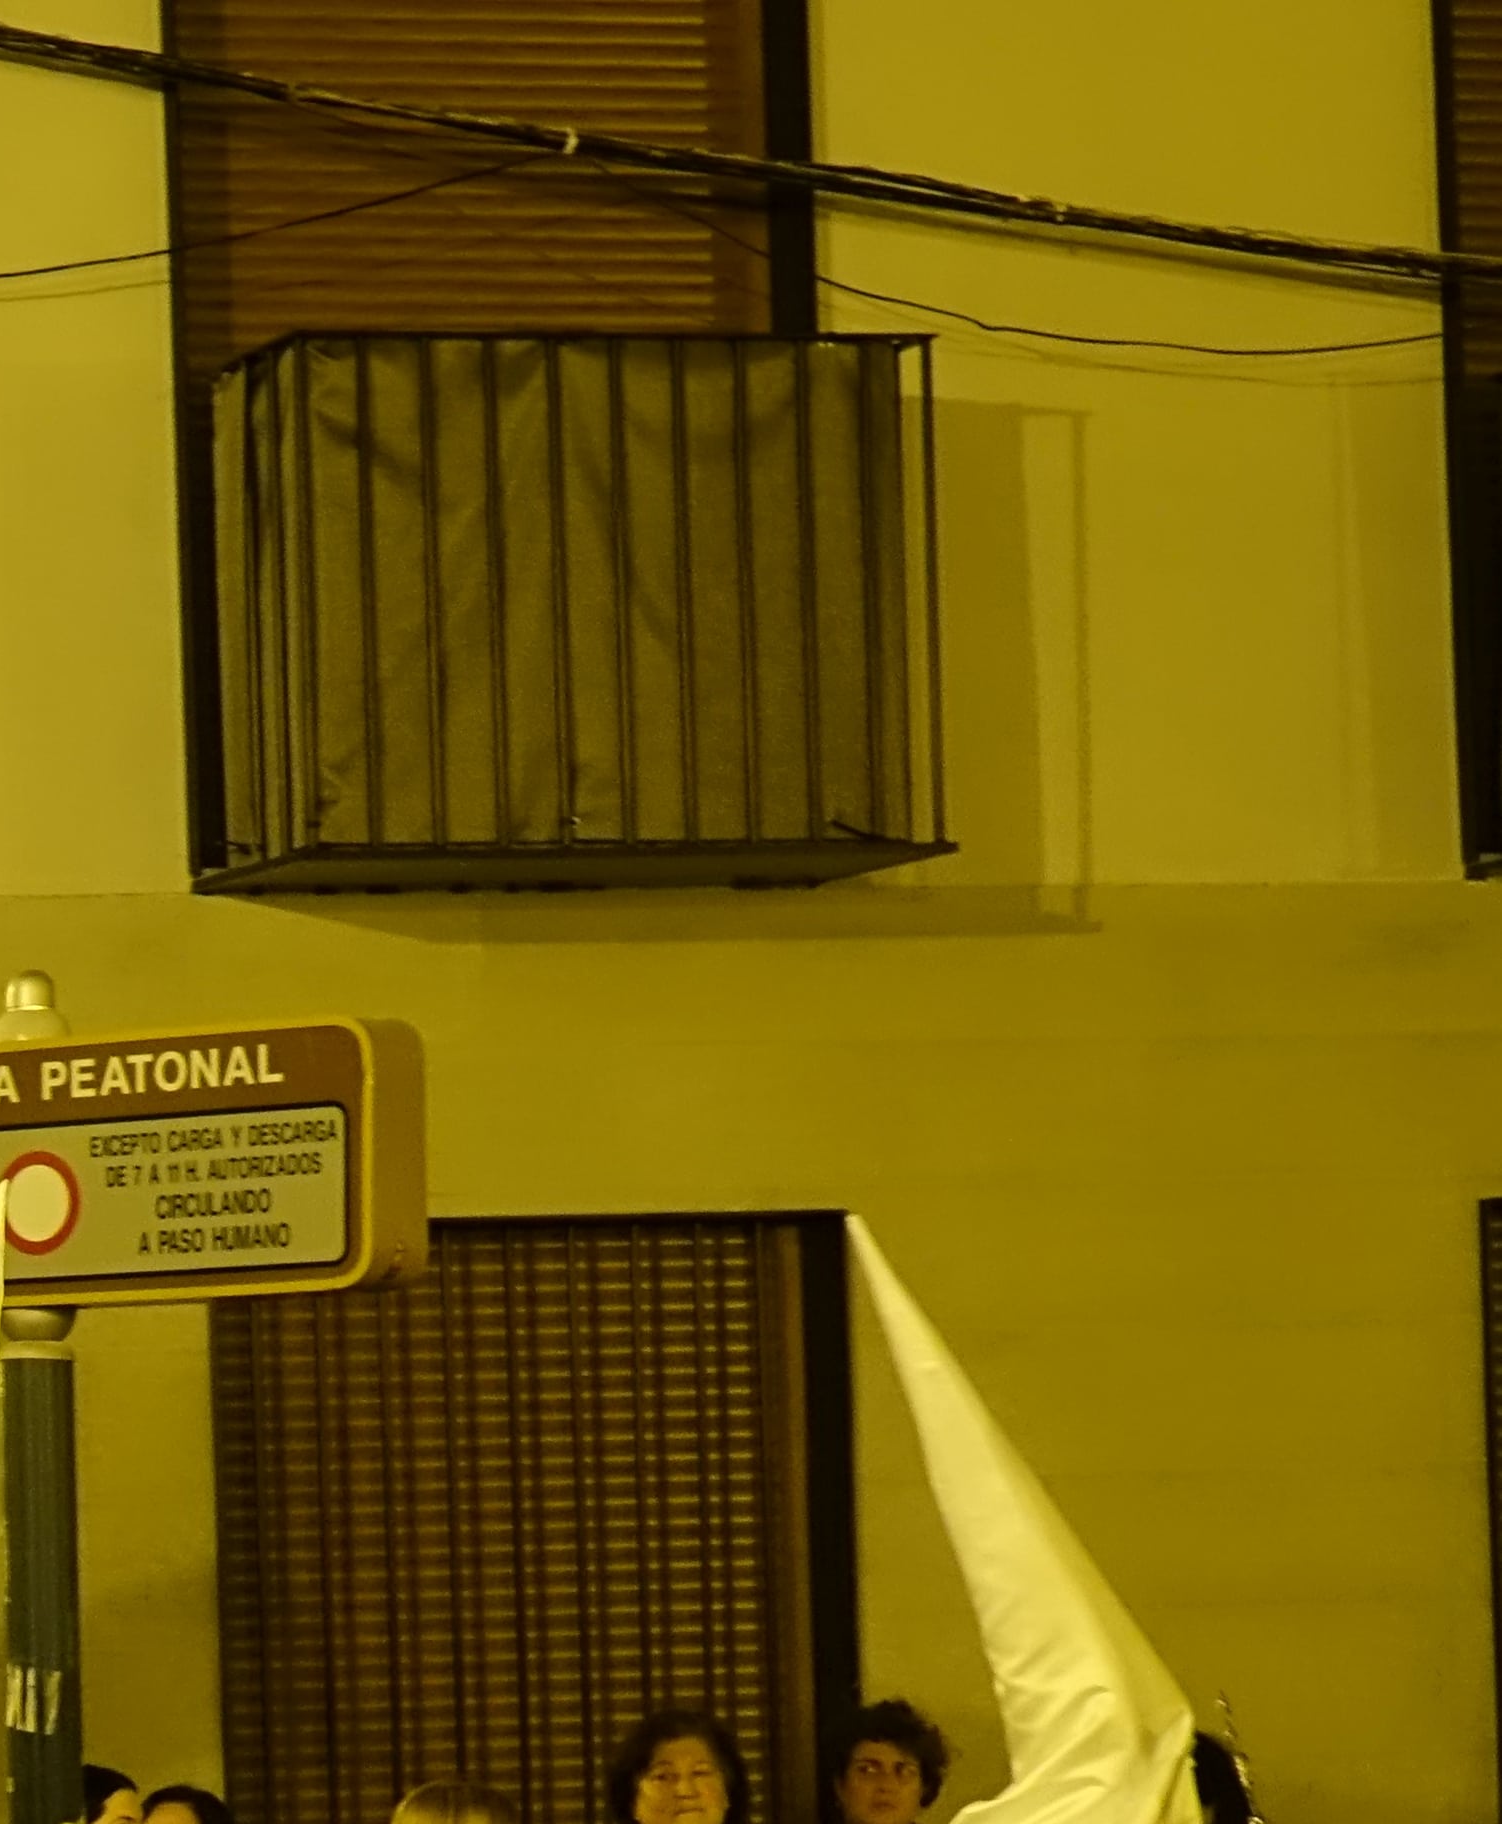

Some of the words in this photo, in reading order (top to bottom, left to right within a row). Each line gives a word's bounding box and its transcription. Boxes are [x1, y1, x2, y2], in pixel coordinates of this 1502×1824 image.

[40, 1043, 284, 1101] PEATONAL
[90, 1132, 161, 1158] EXCEPTO
[167, 1126, 223, 1153] CARGA
[230, 1125, 243, 1148] Y
[248, 1119, 337, 1146] DESCARGA
[106, 1166, 127, 1188] DE
[134, 1165, 142, 1185] 7
[148, 1163, 160, 1184] A
[207, 1151, 322, 1181] AUTORIZADOS
[155, 1188, 270, 1220] CIRCULANDO
[137, 1231, 151, 1255] A
[158, 1227, 205, 1254] PASO
[212, 1221, 290, 1251] HUMANO
